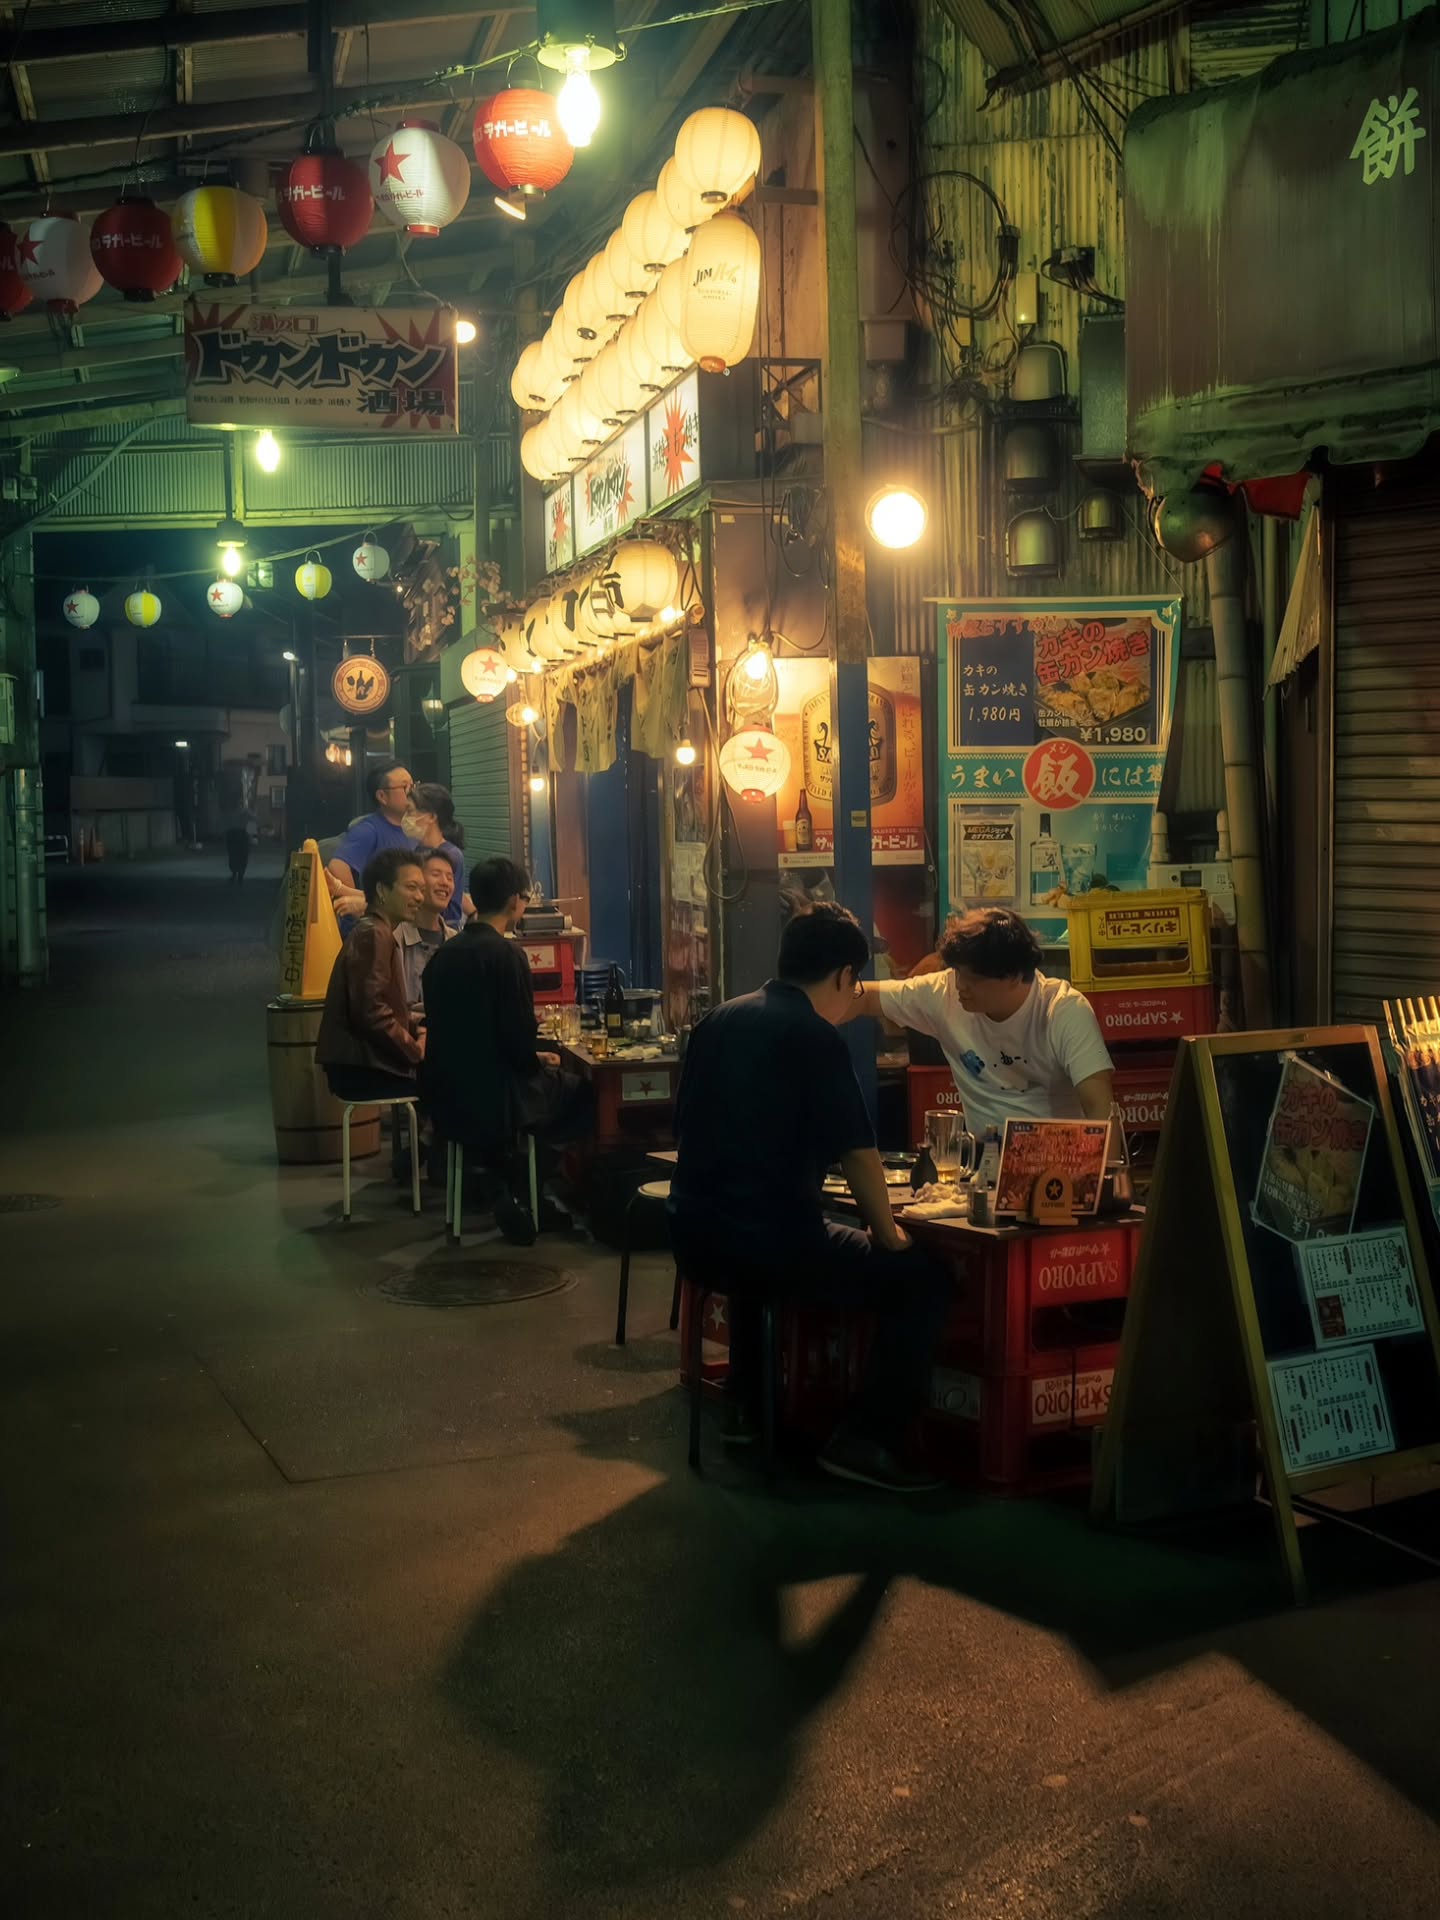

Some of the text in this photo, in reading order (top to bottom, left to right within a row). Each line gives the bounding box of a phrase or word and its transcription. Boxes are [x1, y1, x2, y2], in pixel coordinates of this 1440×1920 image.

[1349, 87, 1427, 185] 餅
[693, 266, 713, 287] JIM
[1037, 621, 1106, 659] カキの
[1035, 631, 1150, 686] 缶カン焼き
[962, 663, 998, 678] カキの
[962, 682, 1029, 698] 缶カン焼き
[1079, 727, 1147, 745] ¥1,980
[1048, 743, 1070, 756] メシ
[951, 765, 1017, 789] うまい
[1032, 752, 1085, 802] 飯
[1110, 921, 1177, 936] キリンビール
[1105, 1011, 1168, 1028] SAPPORO
[1037, 1259, 1119, 1291] SAPPORO
